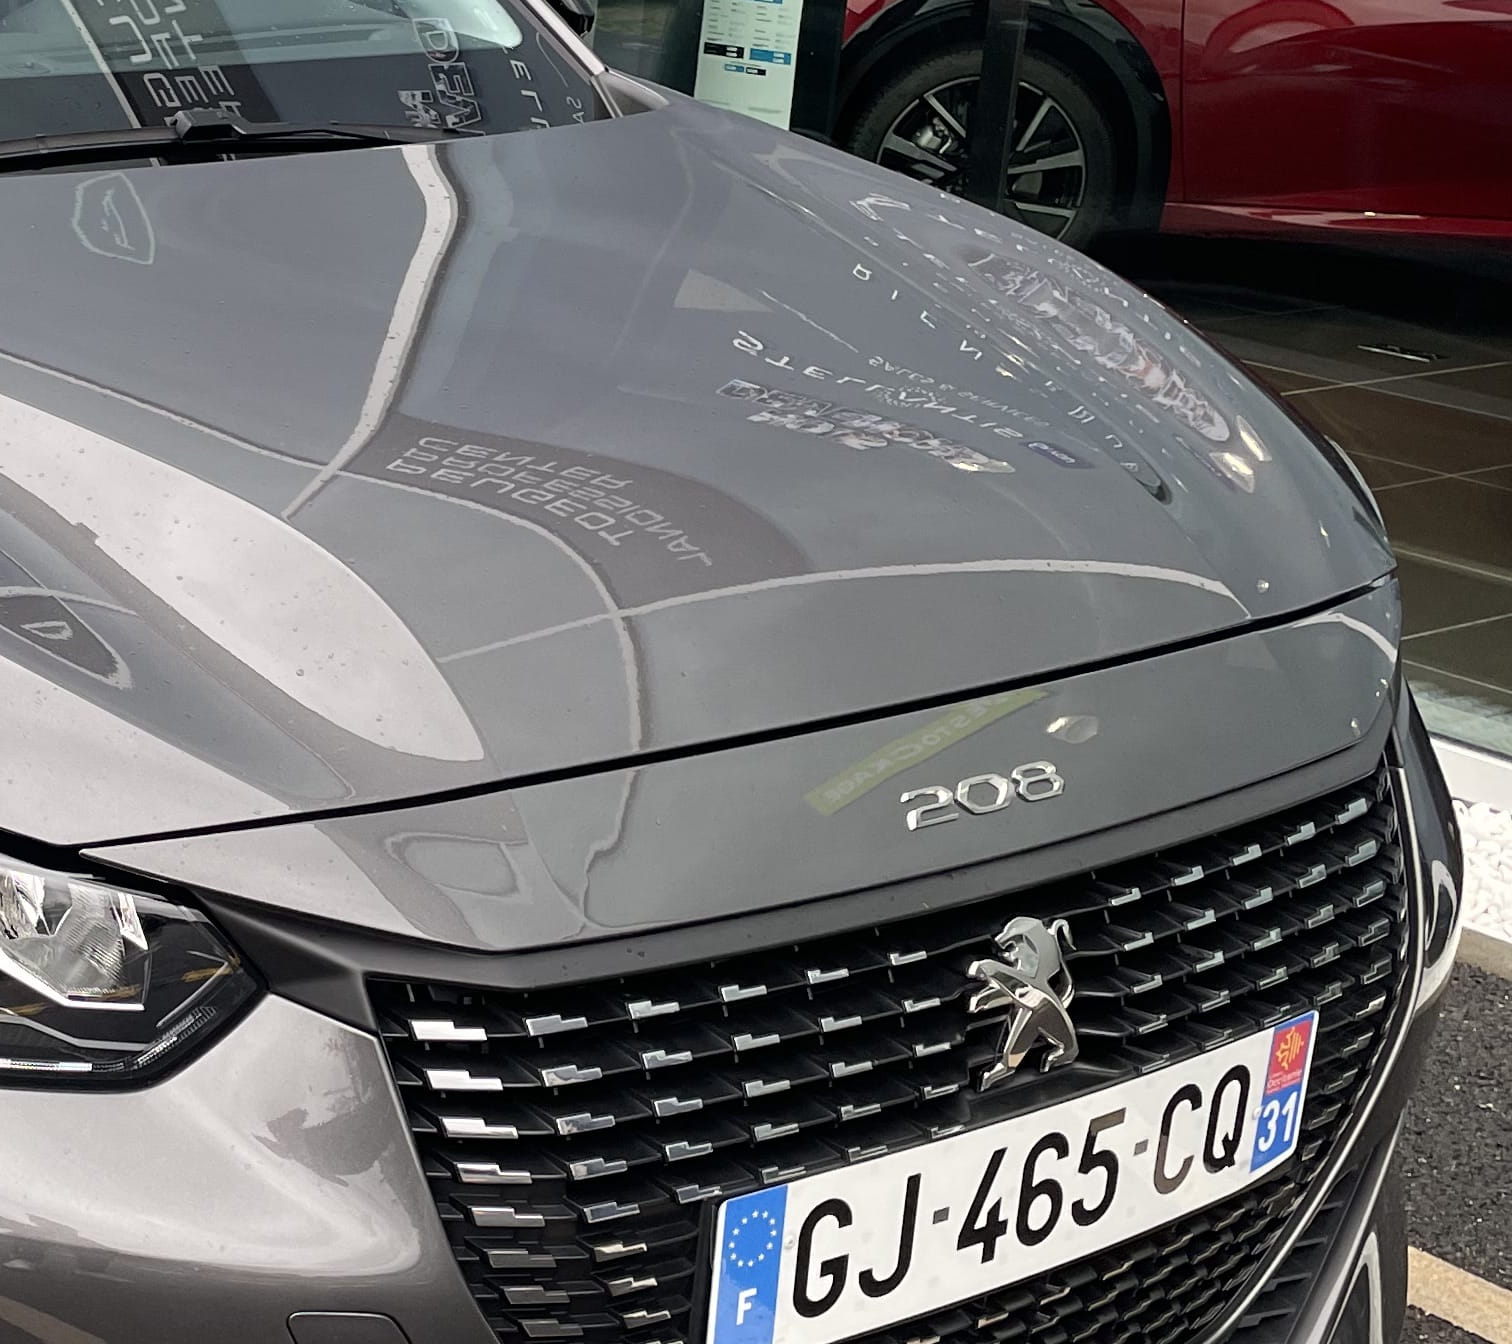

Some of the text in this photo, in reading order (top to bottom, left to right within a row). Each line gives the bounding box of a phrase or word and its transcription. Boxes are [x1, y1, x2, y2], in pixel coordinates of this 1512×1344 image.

[899, 760, 1065, 832] 208
[1257, 1090, 1299, 1153] 31
[791, 1064, 1251, 1318] GJ-465-CQ
[735, 1287, 758, 1327] F
